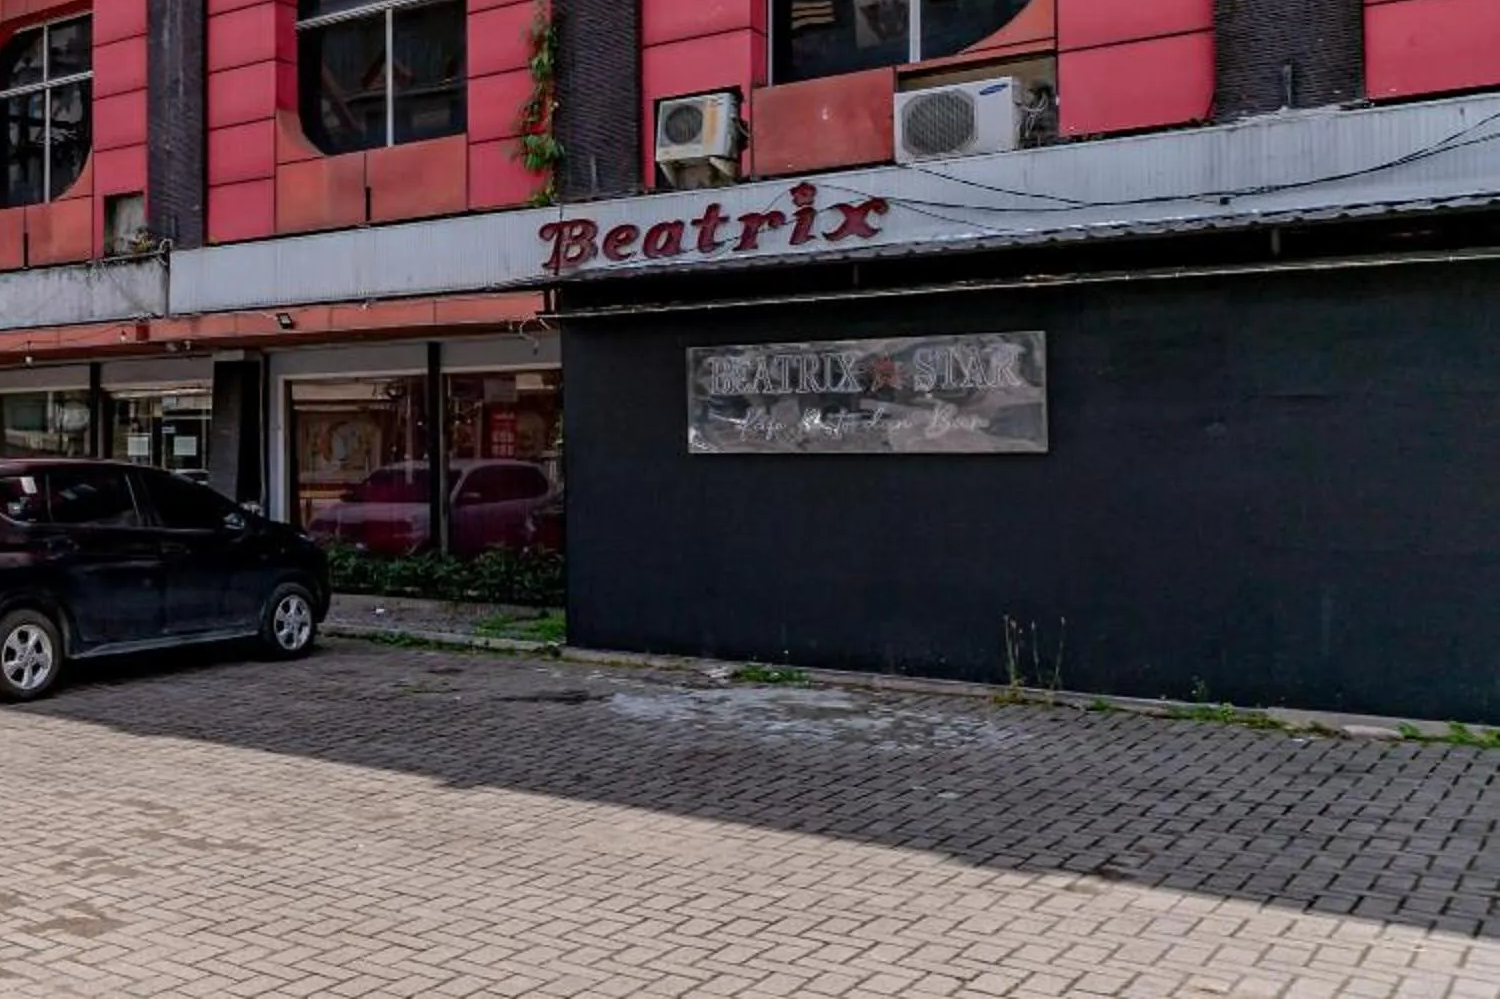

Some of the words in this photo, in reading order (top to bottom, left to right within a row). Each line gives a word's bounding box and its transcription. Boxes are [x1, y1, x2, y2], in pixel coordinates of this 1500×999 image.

[539, 182, 889, 270] Beatrix
[707, 353, 864, 395] BEATRIX
[913, 345, 1023, 392] STAR
